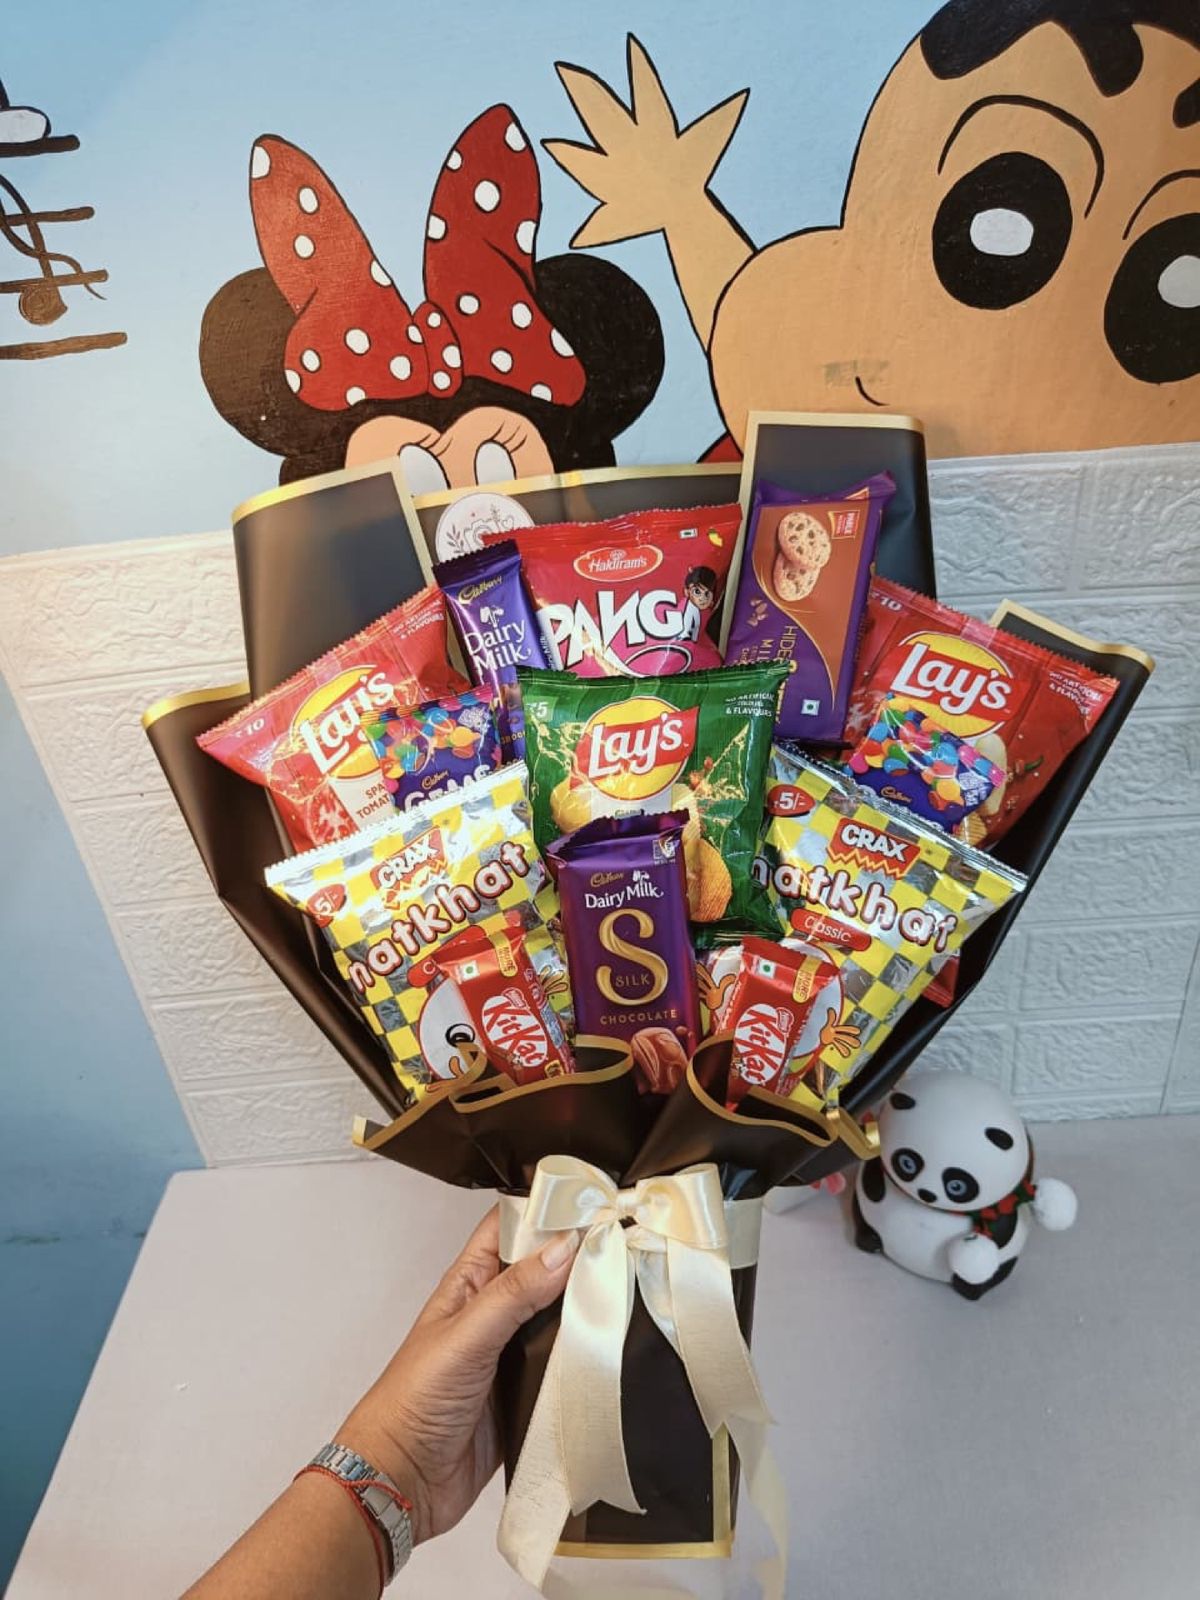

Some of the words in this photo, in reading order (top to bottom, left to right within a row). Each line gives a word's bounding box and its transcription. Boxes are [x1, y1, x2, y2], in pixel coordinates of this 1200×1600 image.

[589, 554, 648, 573] Haldiram's
[464, 618, 526, 657] Dairy
[536, 589, 701, 674] PANGA
[473, 643, 531, 679] Milk
[889, 642, 1012, 715] Lay's
[299, 671, 394, 775] Lay's
[588, 711, 682, 779] Lay's
[377, 834, 439, 889] CRAX
[840, 823, 909, 863] CRAX
[347, 840, 529, 994] natkhat
[585, 890, 627, 911] Dairy
[626, 878, 664, 904] Milk
[750, 854, 959, 953] natkhat
[803, 913, 853, 944] Classic
[615, 972, 651, 988] SILK
[483, 1001, 546, 1065] KitKat
[599, 1008, 679, 1026] CHOCOLATE
[735, 1008, 786, 1083] KitKat
